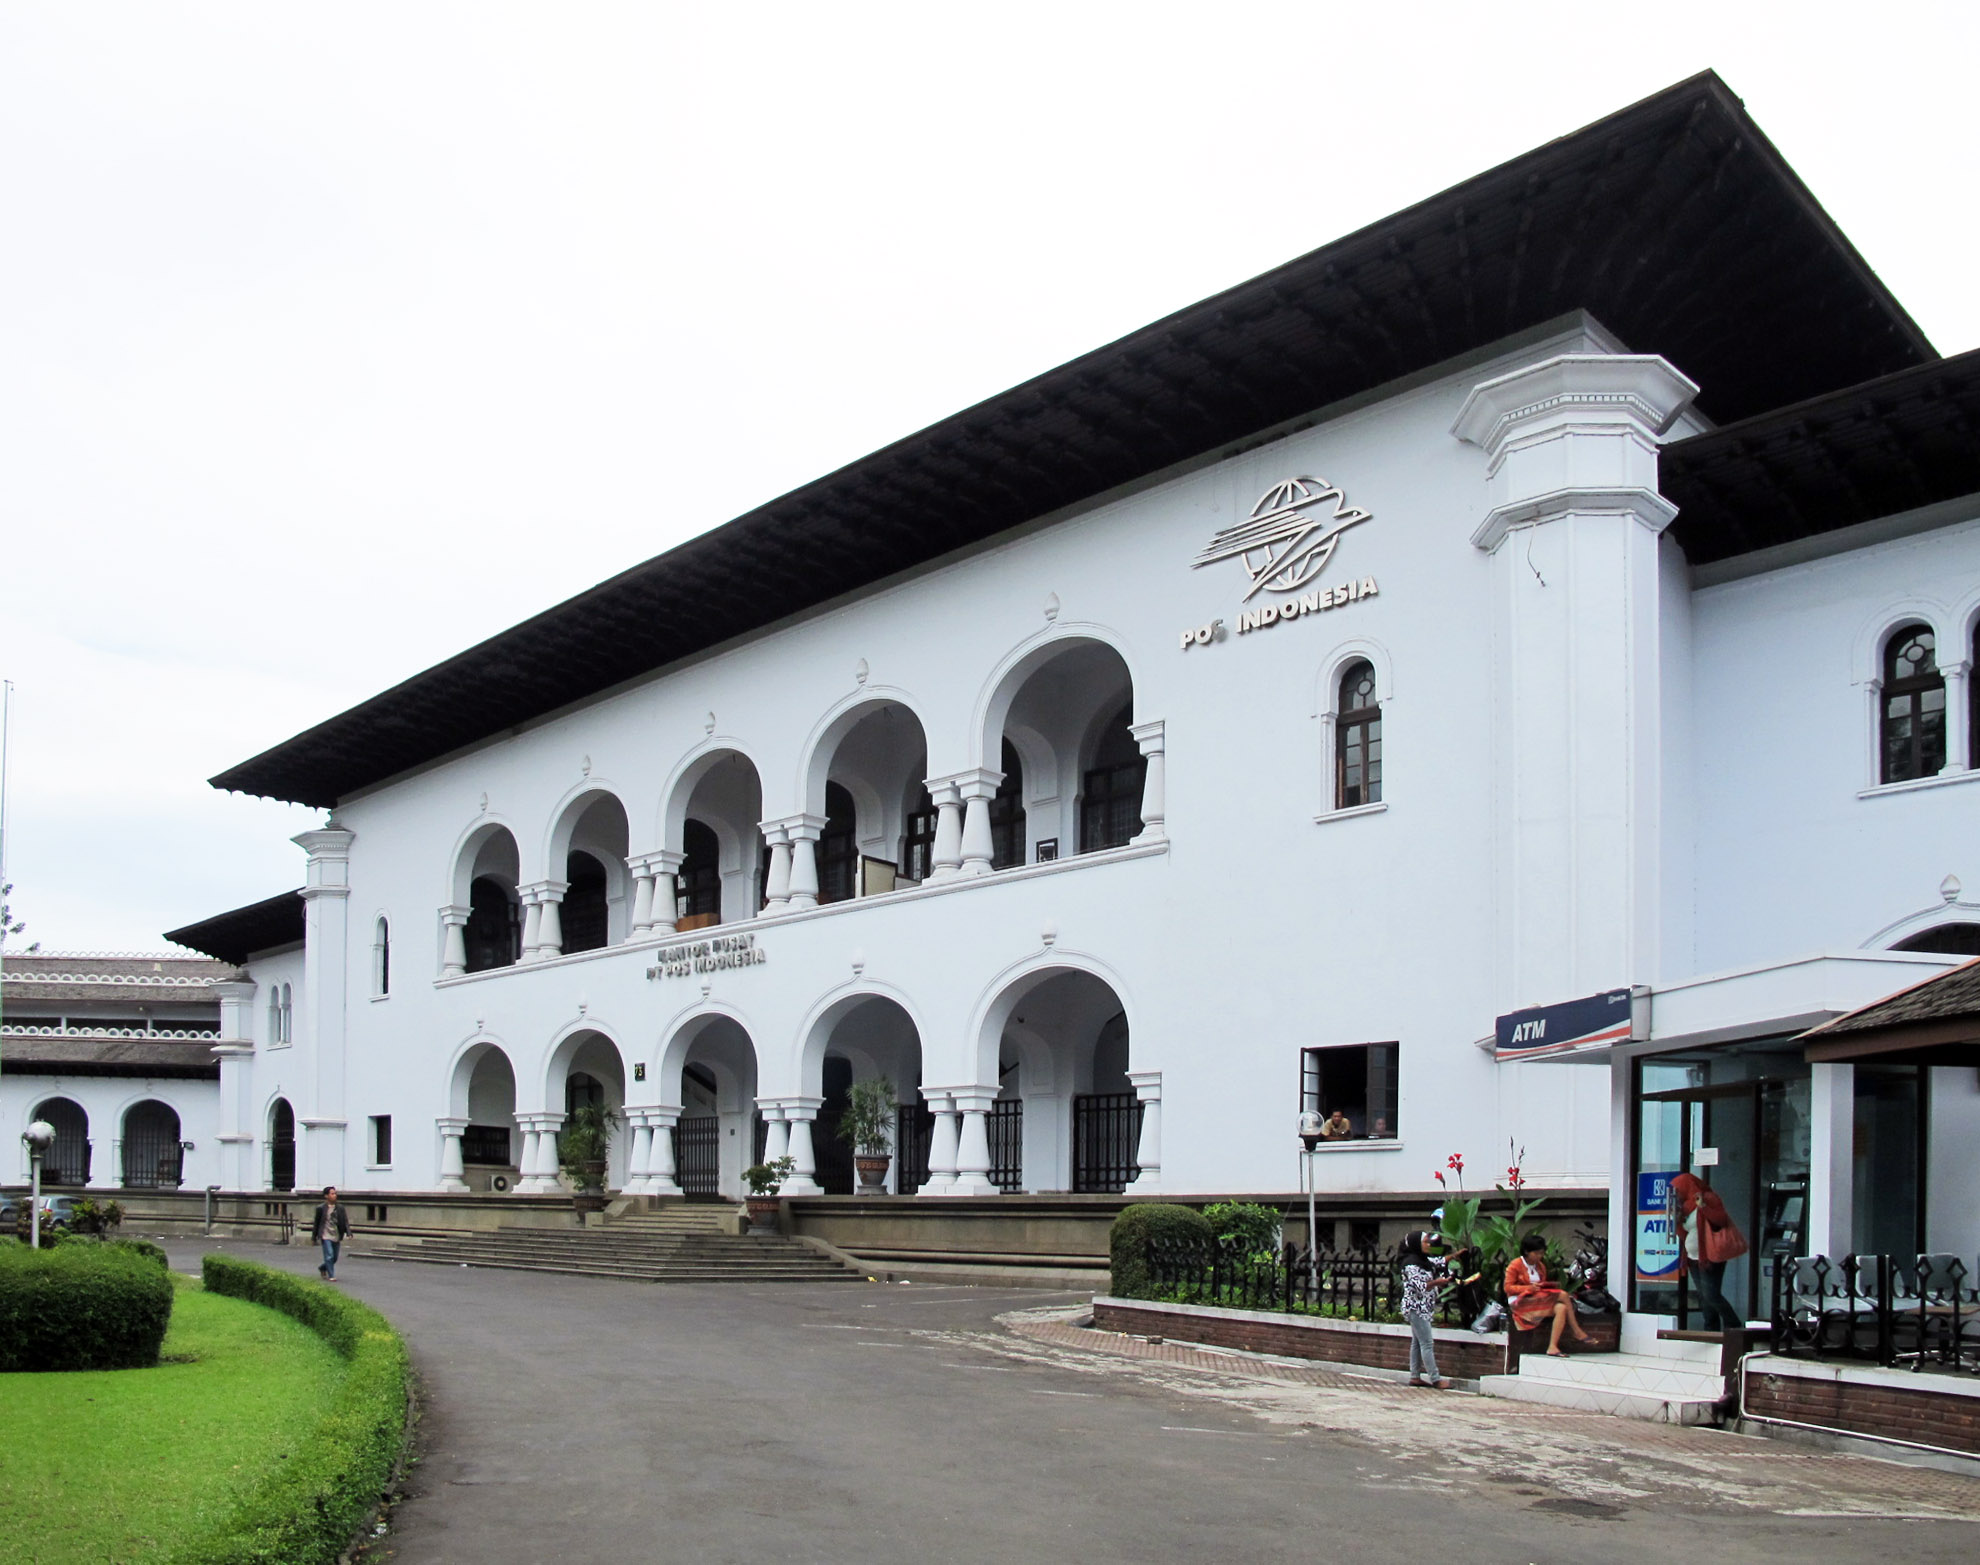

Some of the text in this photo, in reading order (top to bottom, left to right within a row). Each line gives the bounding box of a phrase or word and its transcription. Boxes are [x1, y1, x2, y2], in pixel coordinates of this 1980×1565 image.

[1179, 575, 1379, 649] POS INDONESIA
[658, 933, 755, 962] KANTOR PUSAT
[646, 948, 767, 981] PT POS INDONESIA
[1512, 1019, 1546, 1043] ATM
